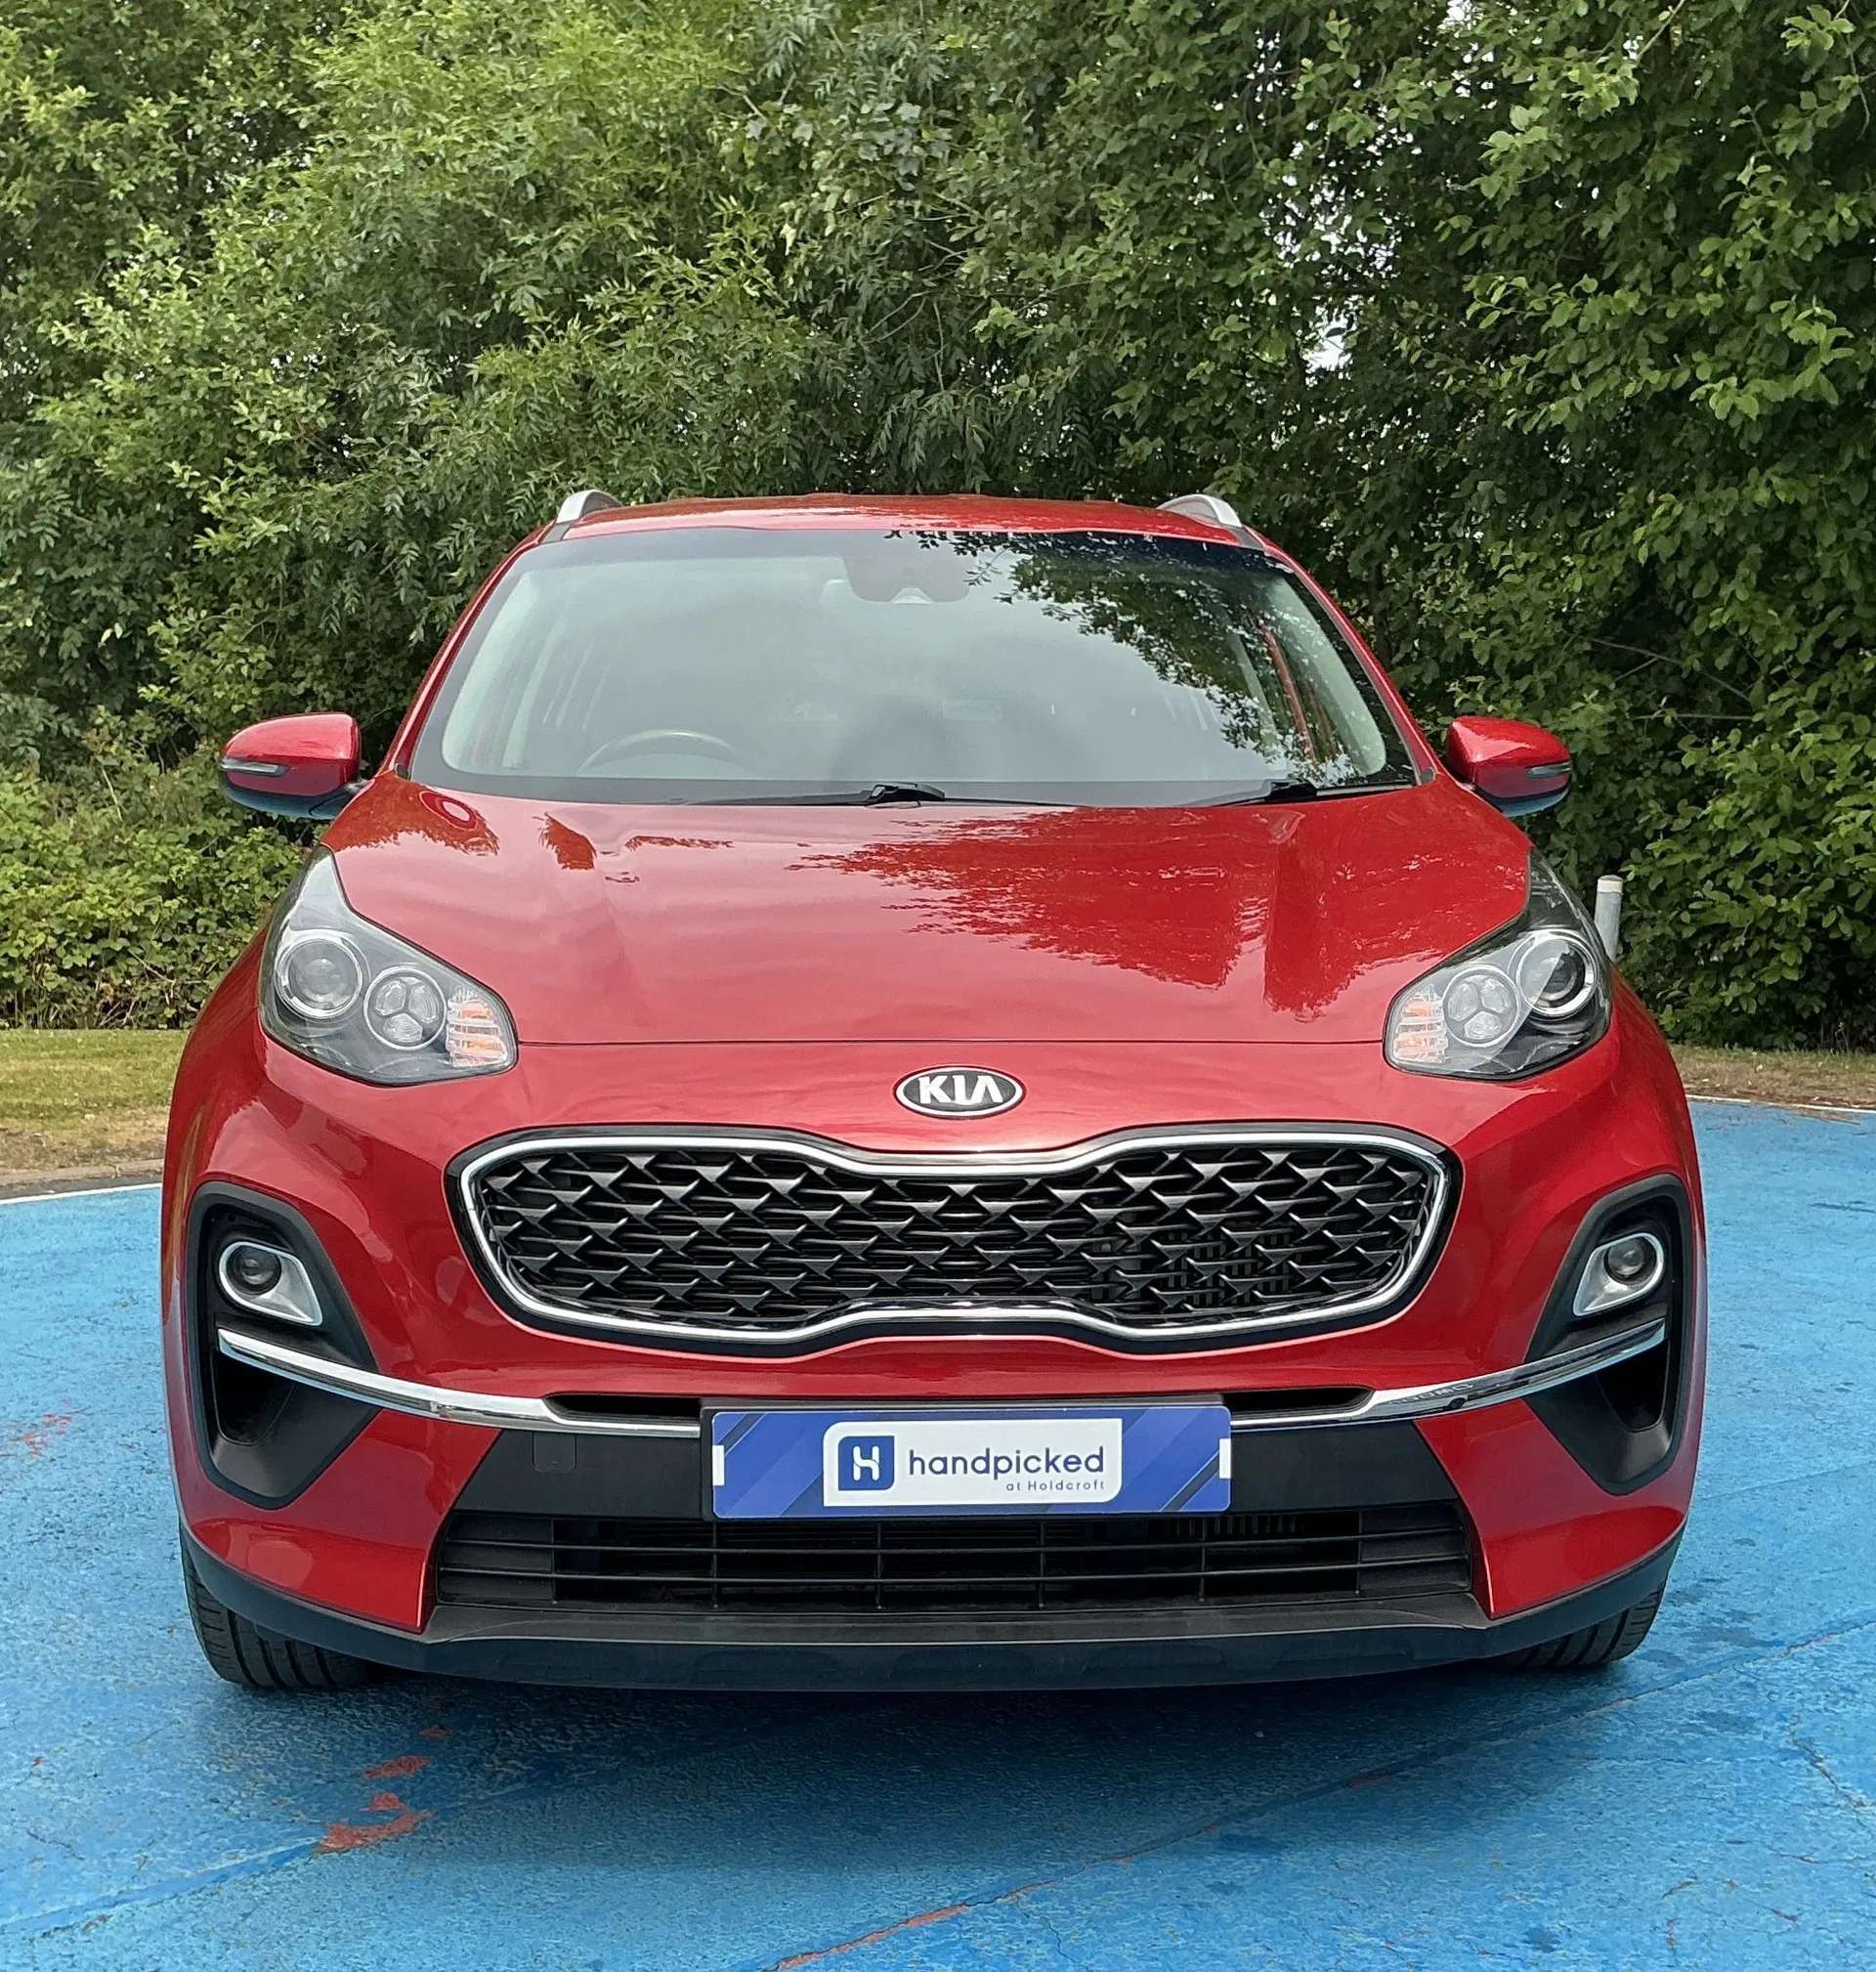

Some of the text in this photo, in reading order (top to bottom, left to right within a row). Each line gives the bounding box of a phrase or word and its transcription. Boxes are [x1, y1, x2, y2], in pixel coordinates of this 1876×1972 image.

[918, 1075, 1003, 1105] KIA
[852, 1445, 880, 1480] H
[909, 1446, 1104, 1479] handpicked
[1005, 1479, 1105, 1493] at Holdcroft
